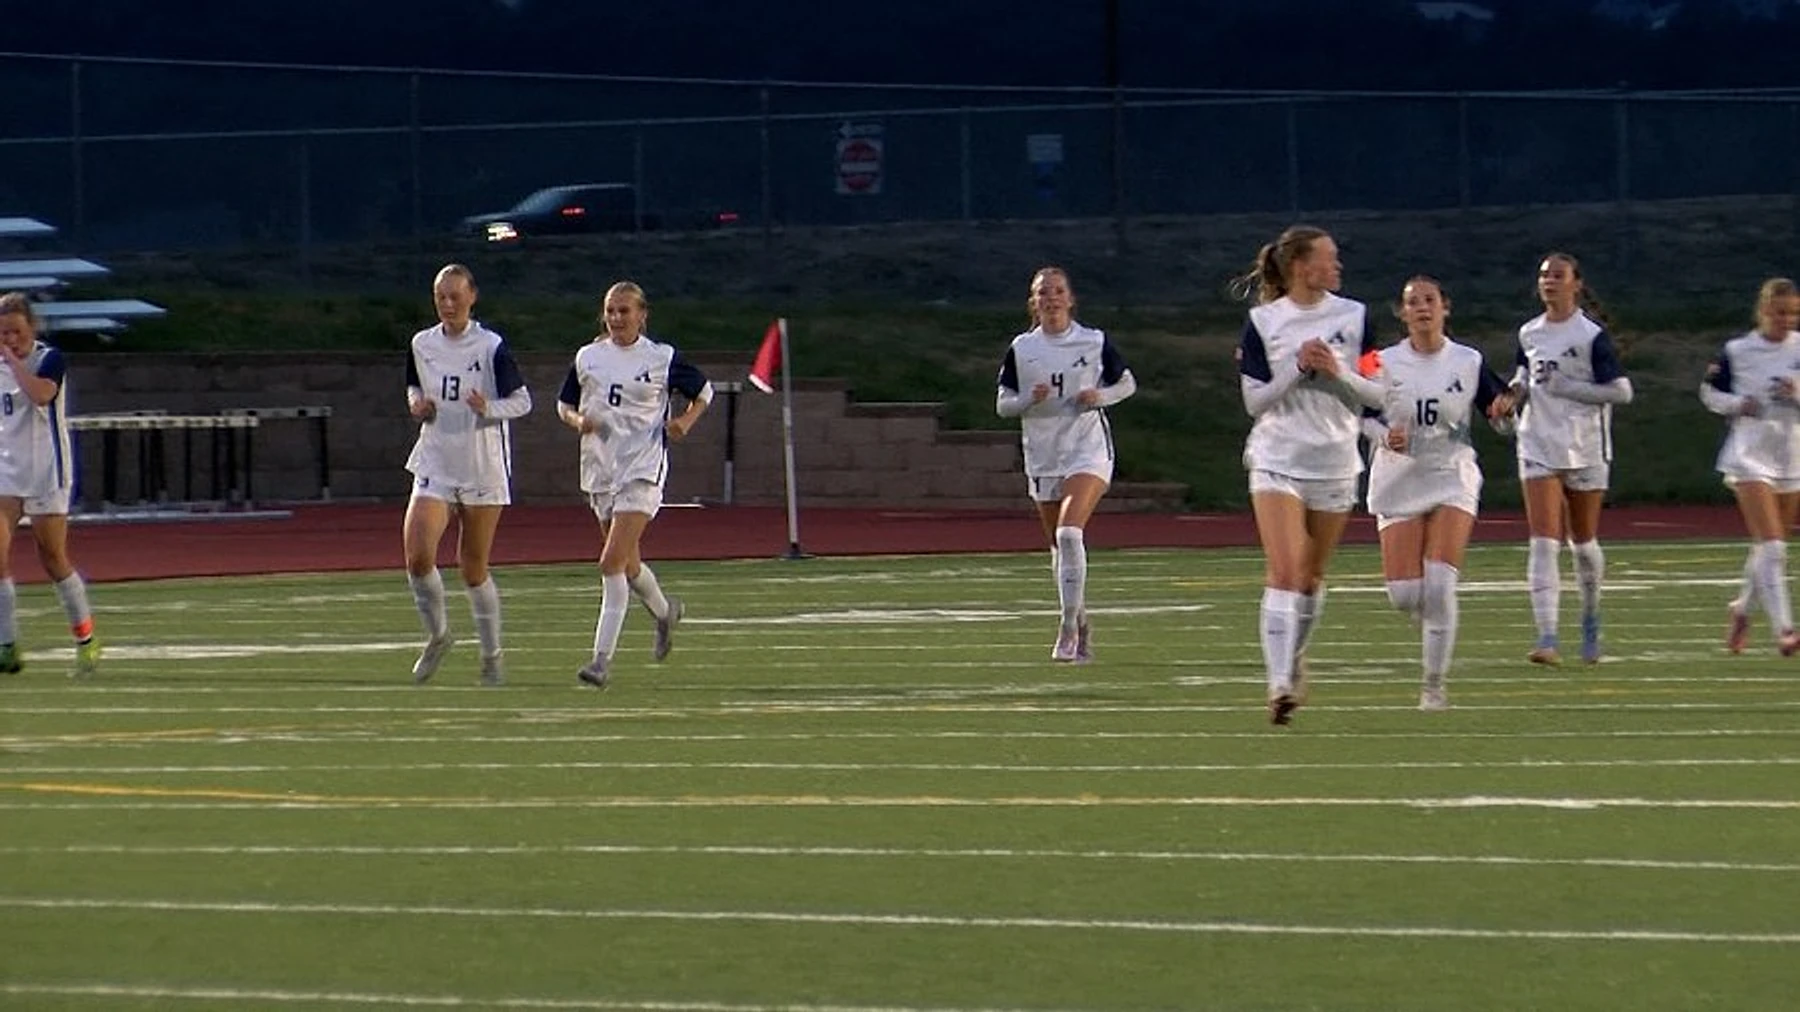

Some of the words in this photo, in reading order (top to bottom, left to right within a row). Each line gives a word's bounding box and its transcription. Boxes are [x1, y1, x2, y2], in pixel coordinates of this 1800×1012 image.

[442, 375, 460, 401] 13
[609, 384, 623, 407] 6
[1051, 372, 1063, 398] 4
[1416, 398, 1439, 427] 16
